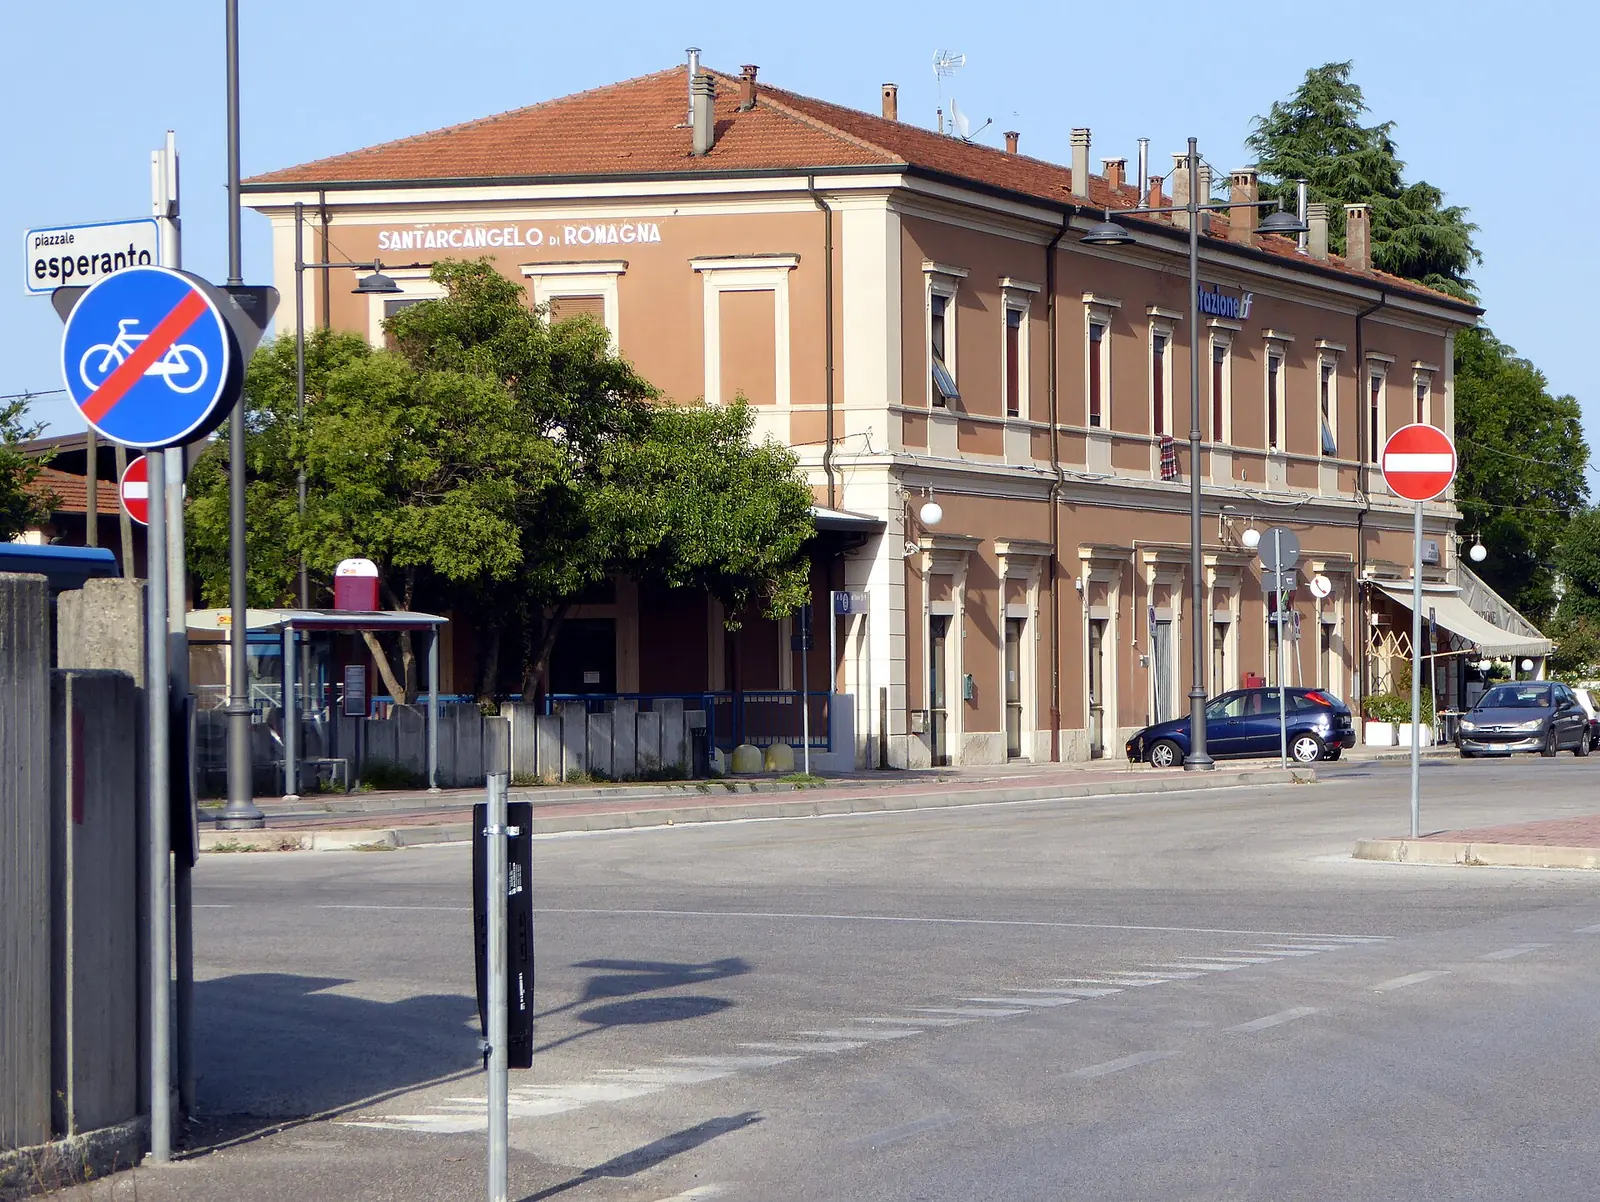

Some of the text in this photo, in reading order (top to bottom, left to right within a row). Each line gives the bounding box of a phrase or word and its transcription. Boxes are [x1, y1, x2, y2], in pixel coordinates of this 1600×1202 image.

[35, 232, 75, 249] piazzale
[378, 223, 661, 250] SANTARCANGELO DI ROMAGNA
[35, 244, 151, 284] esperanto
[1196, 284, 1239, 319] tazione
